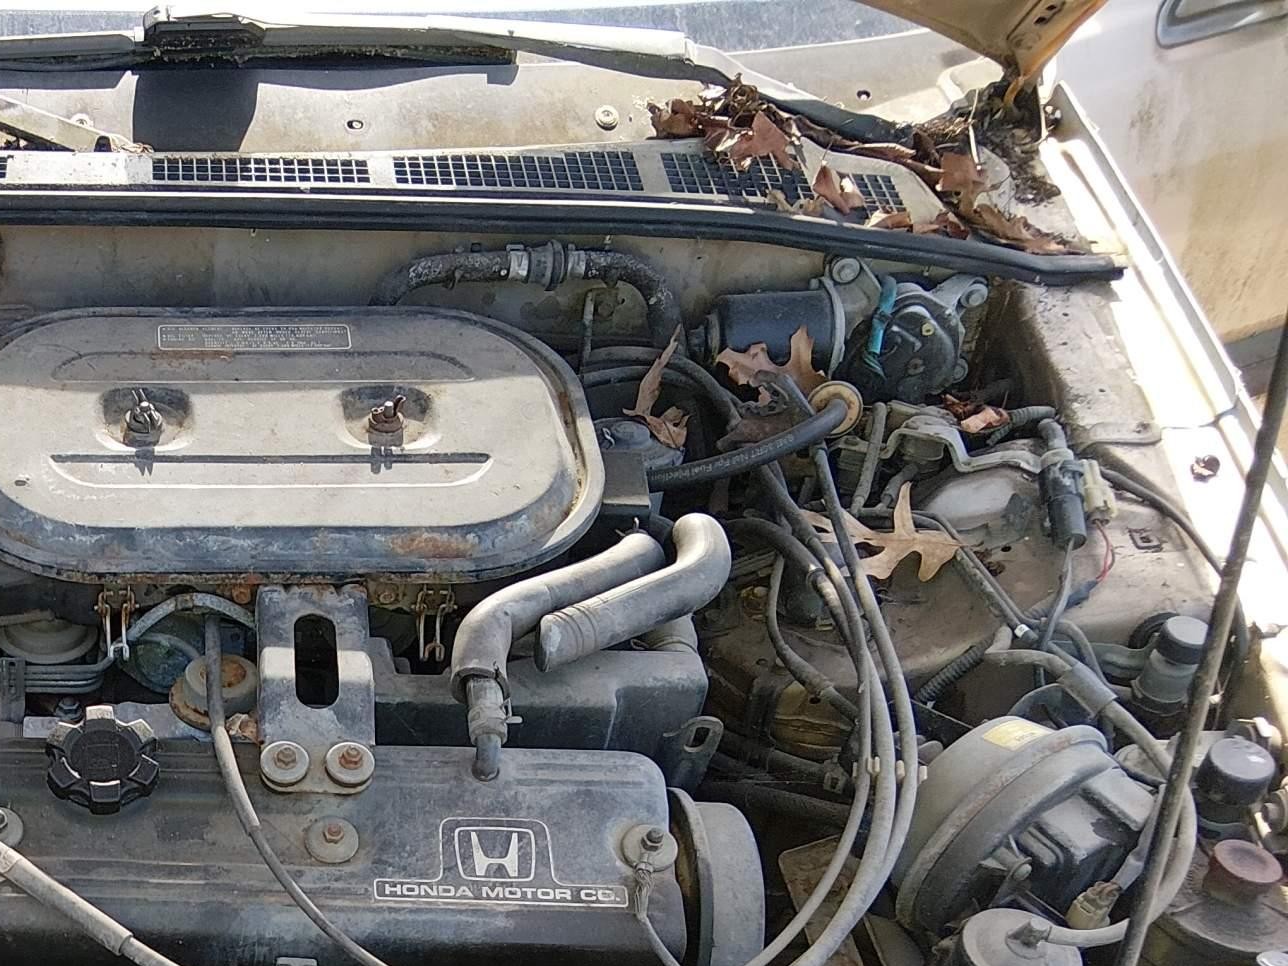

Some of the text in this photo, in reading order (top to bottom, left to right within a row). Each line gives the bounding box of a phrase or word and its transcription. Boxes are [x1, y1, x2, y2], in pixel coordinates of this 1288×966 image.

[691, 463, 713, 475] Fuel
[384, 883, 621, 901] HONDA MOTOR CO.
